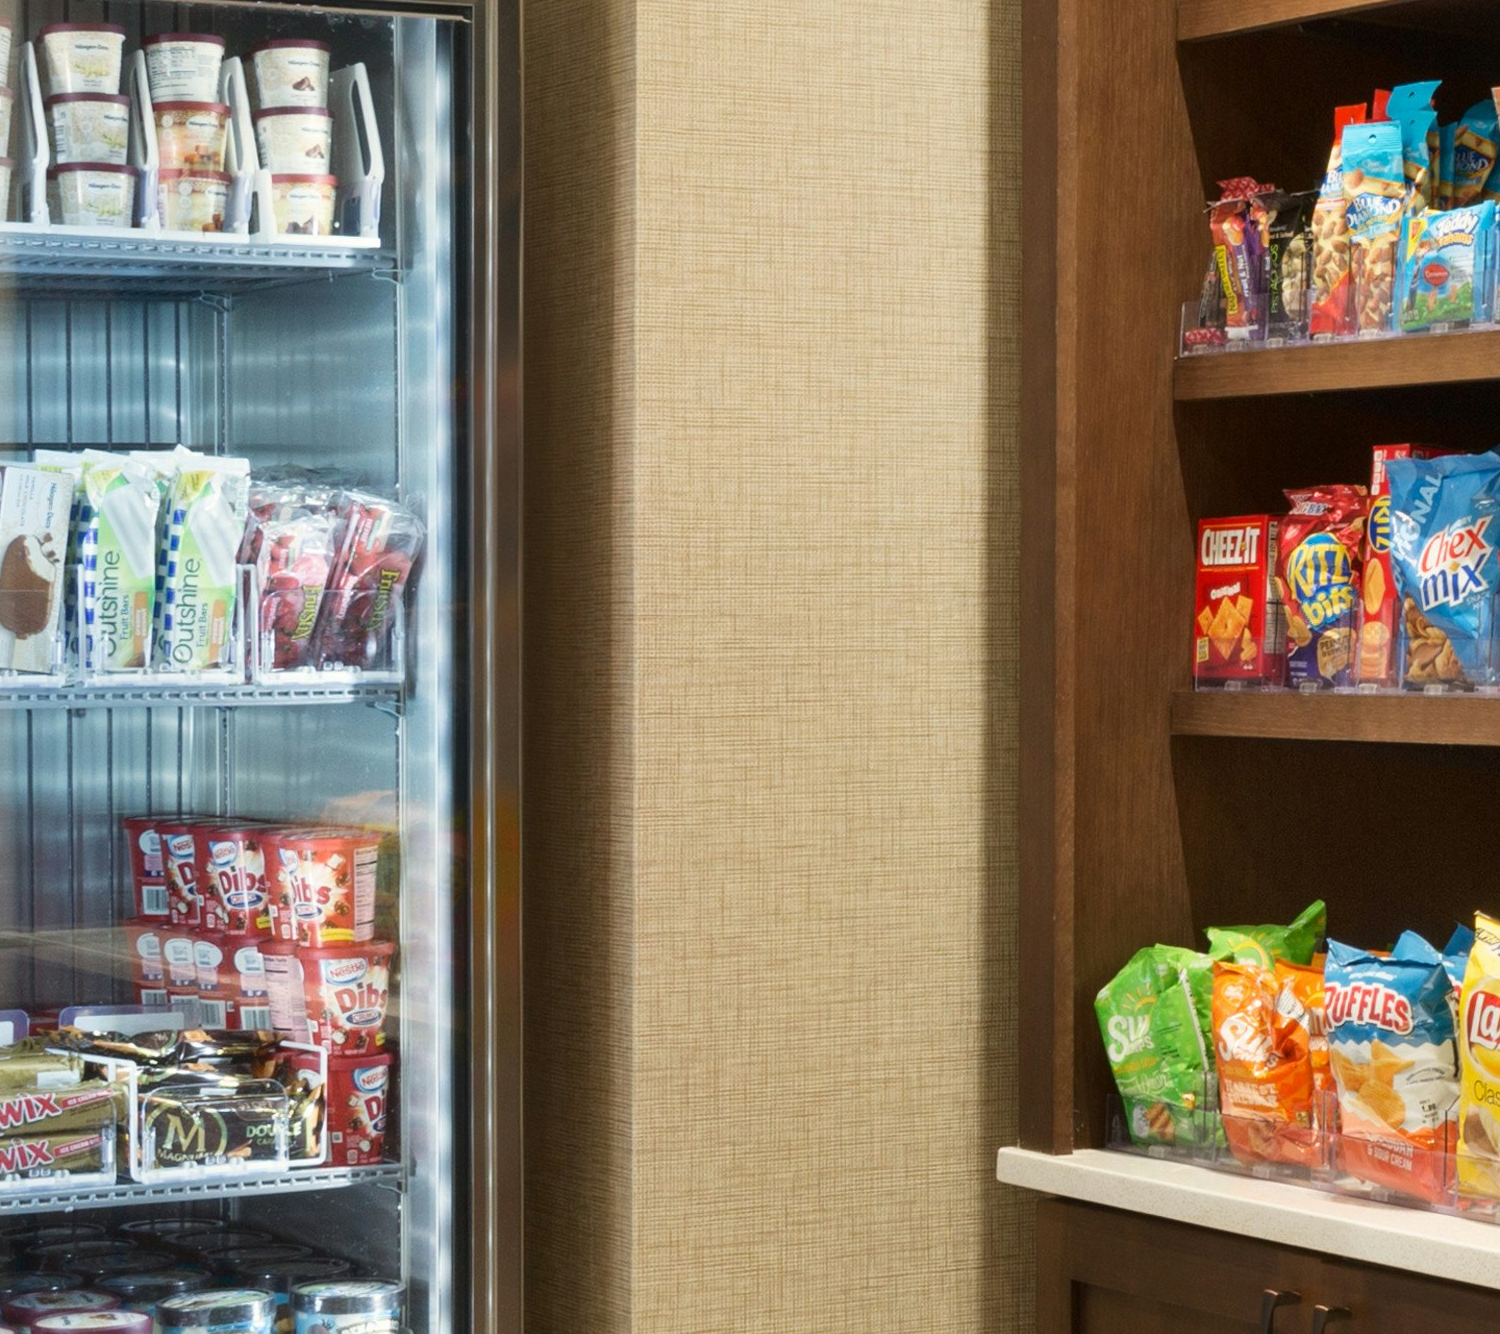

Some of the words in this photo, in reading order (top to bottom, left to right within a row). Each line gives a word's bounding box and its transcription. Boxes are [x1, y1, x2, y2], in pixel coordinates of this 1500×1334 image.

[1346, 199, 1400, 228] DIAMOND
[1352, 194, 1382, 212] BLUE
[1437, 210, 1478, 233] Teddy
[1421, 517, 1493, 574] Chex
[1287, 543, 1353, 599] RITZ
[1421, 554, 1484, 610] mix
[172, 557, 201, 665] Outshine
[1301, 585, 1354, 626] bits
[218, 867, 269, 894] Dibs
[334, 983, 387, 1016] Dibs
[1324, 982, 1414, 1035] RUFFLES
